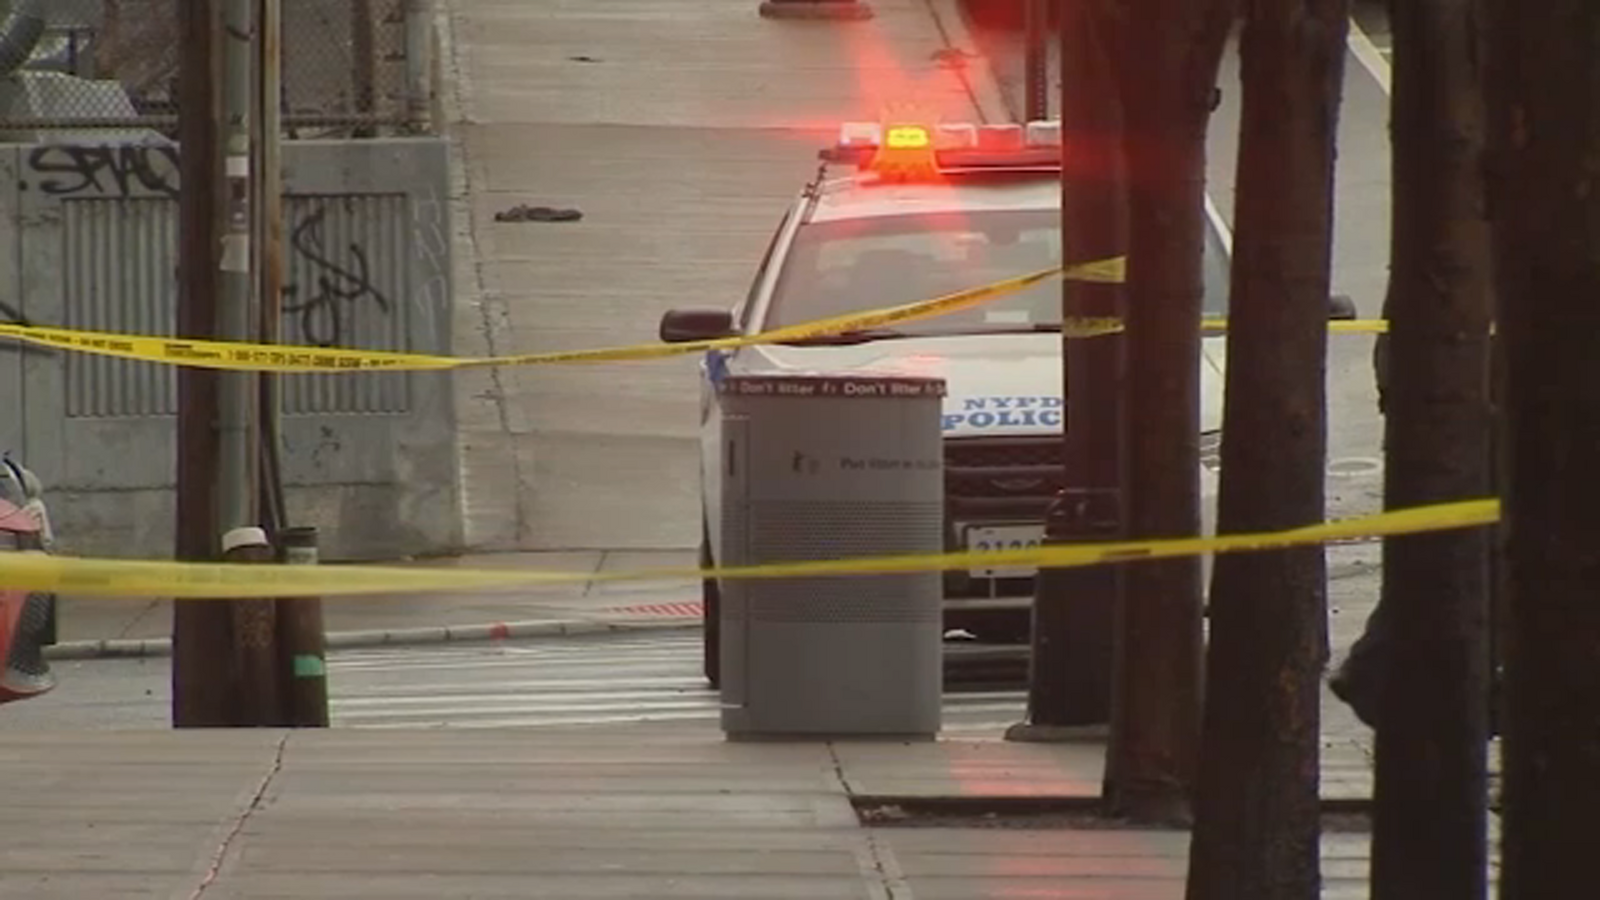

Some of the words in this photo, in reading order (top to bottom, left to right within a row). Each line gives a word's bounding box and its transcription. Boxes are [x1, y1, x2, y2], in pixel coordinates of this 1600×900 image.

[740, 381, 772, 393] Don't
[844, 381, 886, 395] Don't
[963, 396, 1064, 411] NYPD
[940, 410, 1062, 430] POLIC
